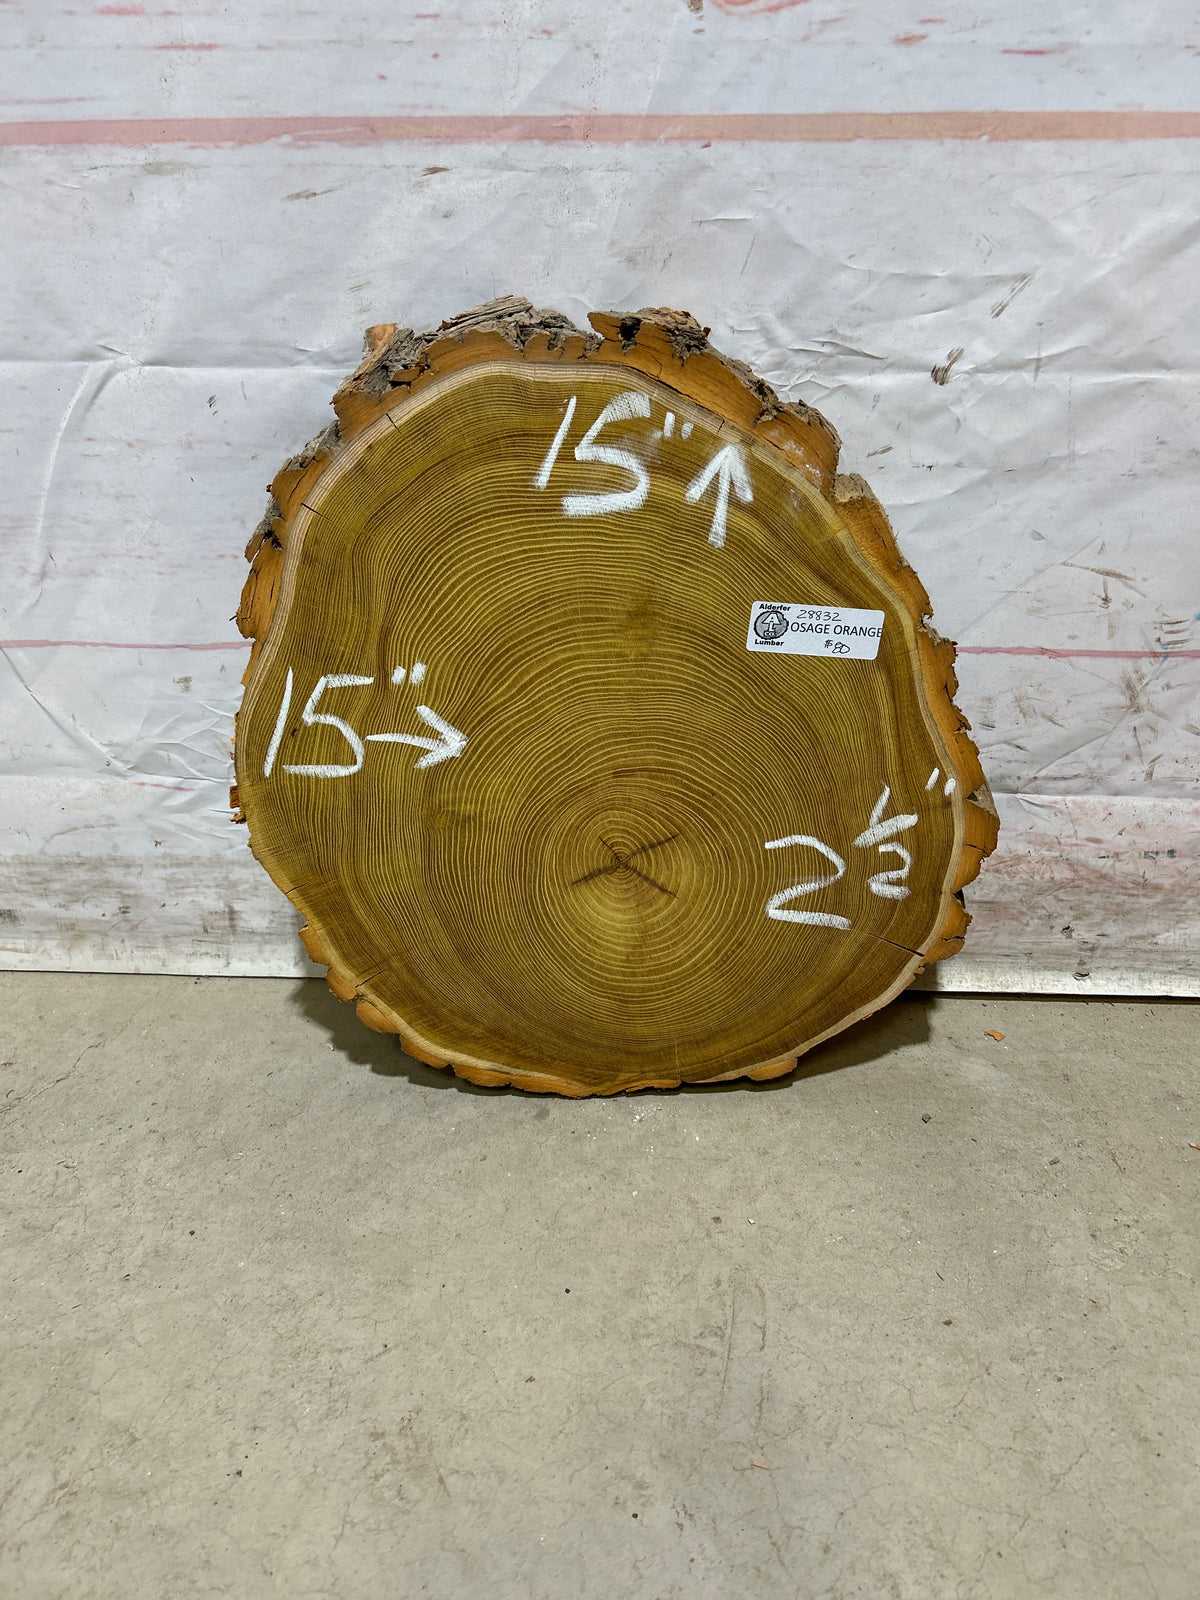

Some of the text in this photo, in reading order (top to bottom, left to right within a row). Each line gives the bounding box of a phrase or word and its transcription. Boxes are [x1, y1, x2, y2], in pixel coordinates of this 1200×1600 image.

[533, 391, 694, 517] 15"
[759, 603, 791, 612] Alderfer
[796, 609, 842, 622] 28832
[790, 621, 882, 638] OSAGE ORANGE
[754, 638, 784, 647] Lumber
[263, 660, 427, 778] 15"
